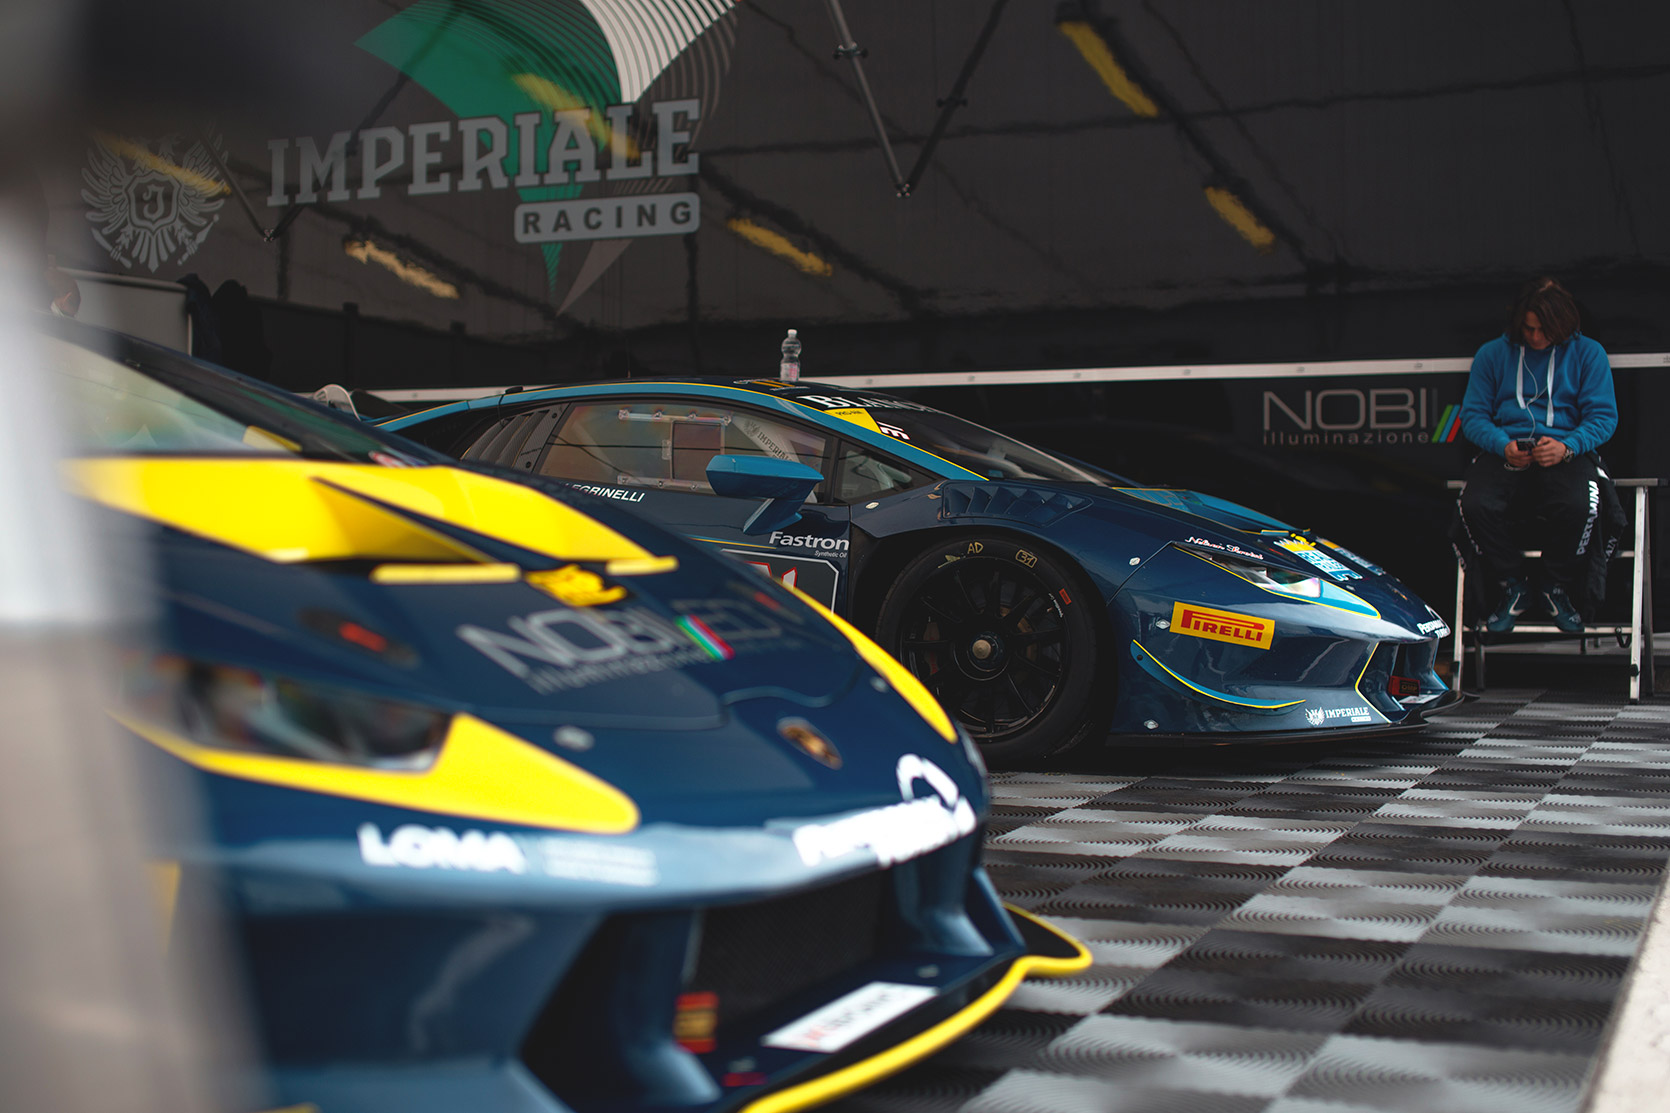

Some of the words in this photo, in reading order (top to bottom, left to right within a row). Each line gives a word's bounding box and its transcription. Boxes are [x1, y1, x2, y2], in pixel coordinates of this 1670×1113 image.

[267, 99, 699, 207] IMPERIALE
[522, 202, 692, 235] RACING
[1263, 387, 1427, 430] NOBI
[757, 431, 793, 461] IMPERIAL
[1263, 430, 1429, 445] illuminazione
[769, 531, 850, 551] Fastron
[814, 550, 839, 558] Synthetic
[1181, 609, 1265, 642] PIRELLI
[1324, 707, 1370, 719] IMPERIALE
